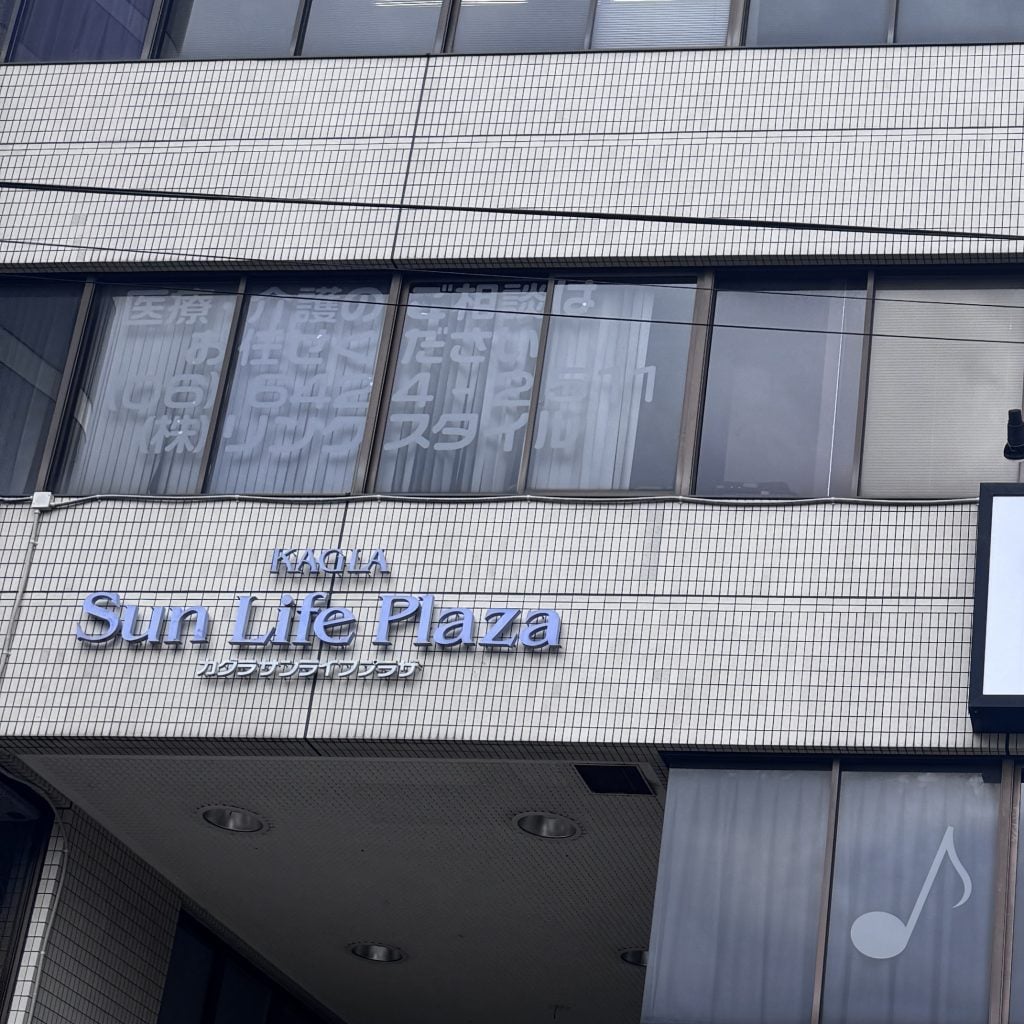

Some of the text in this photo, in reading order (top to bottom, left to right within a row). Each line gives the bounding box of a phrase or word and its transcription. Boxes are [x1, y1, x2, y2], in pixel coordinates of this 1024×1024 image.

[269, 547, 391, 575] KAGLA
[76, 591, 563, 649] Sun Life Plaza
